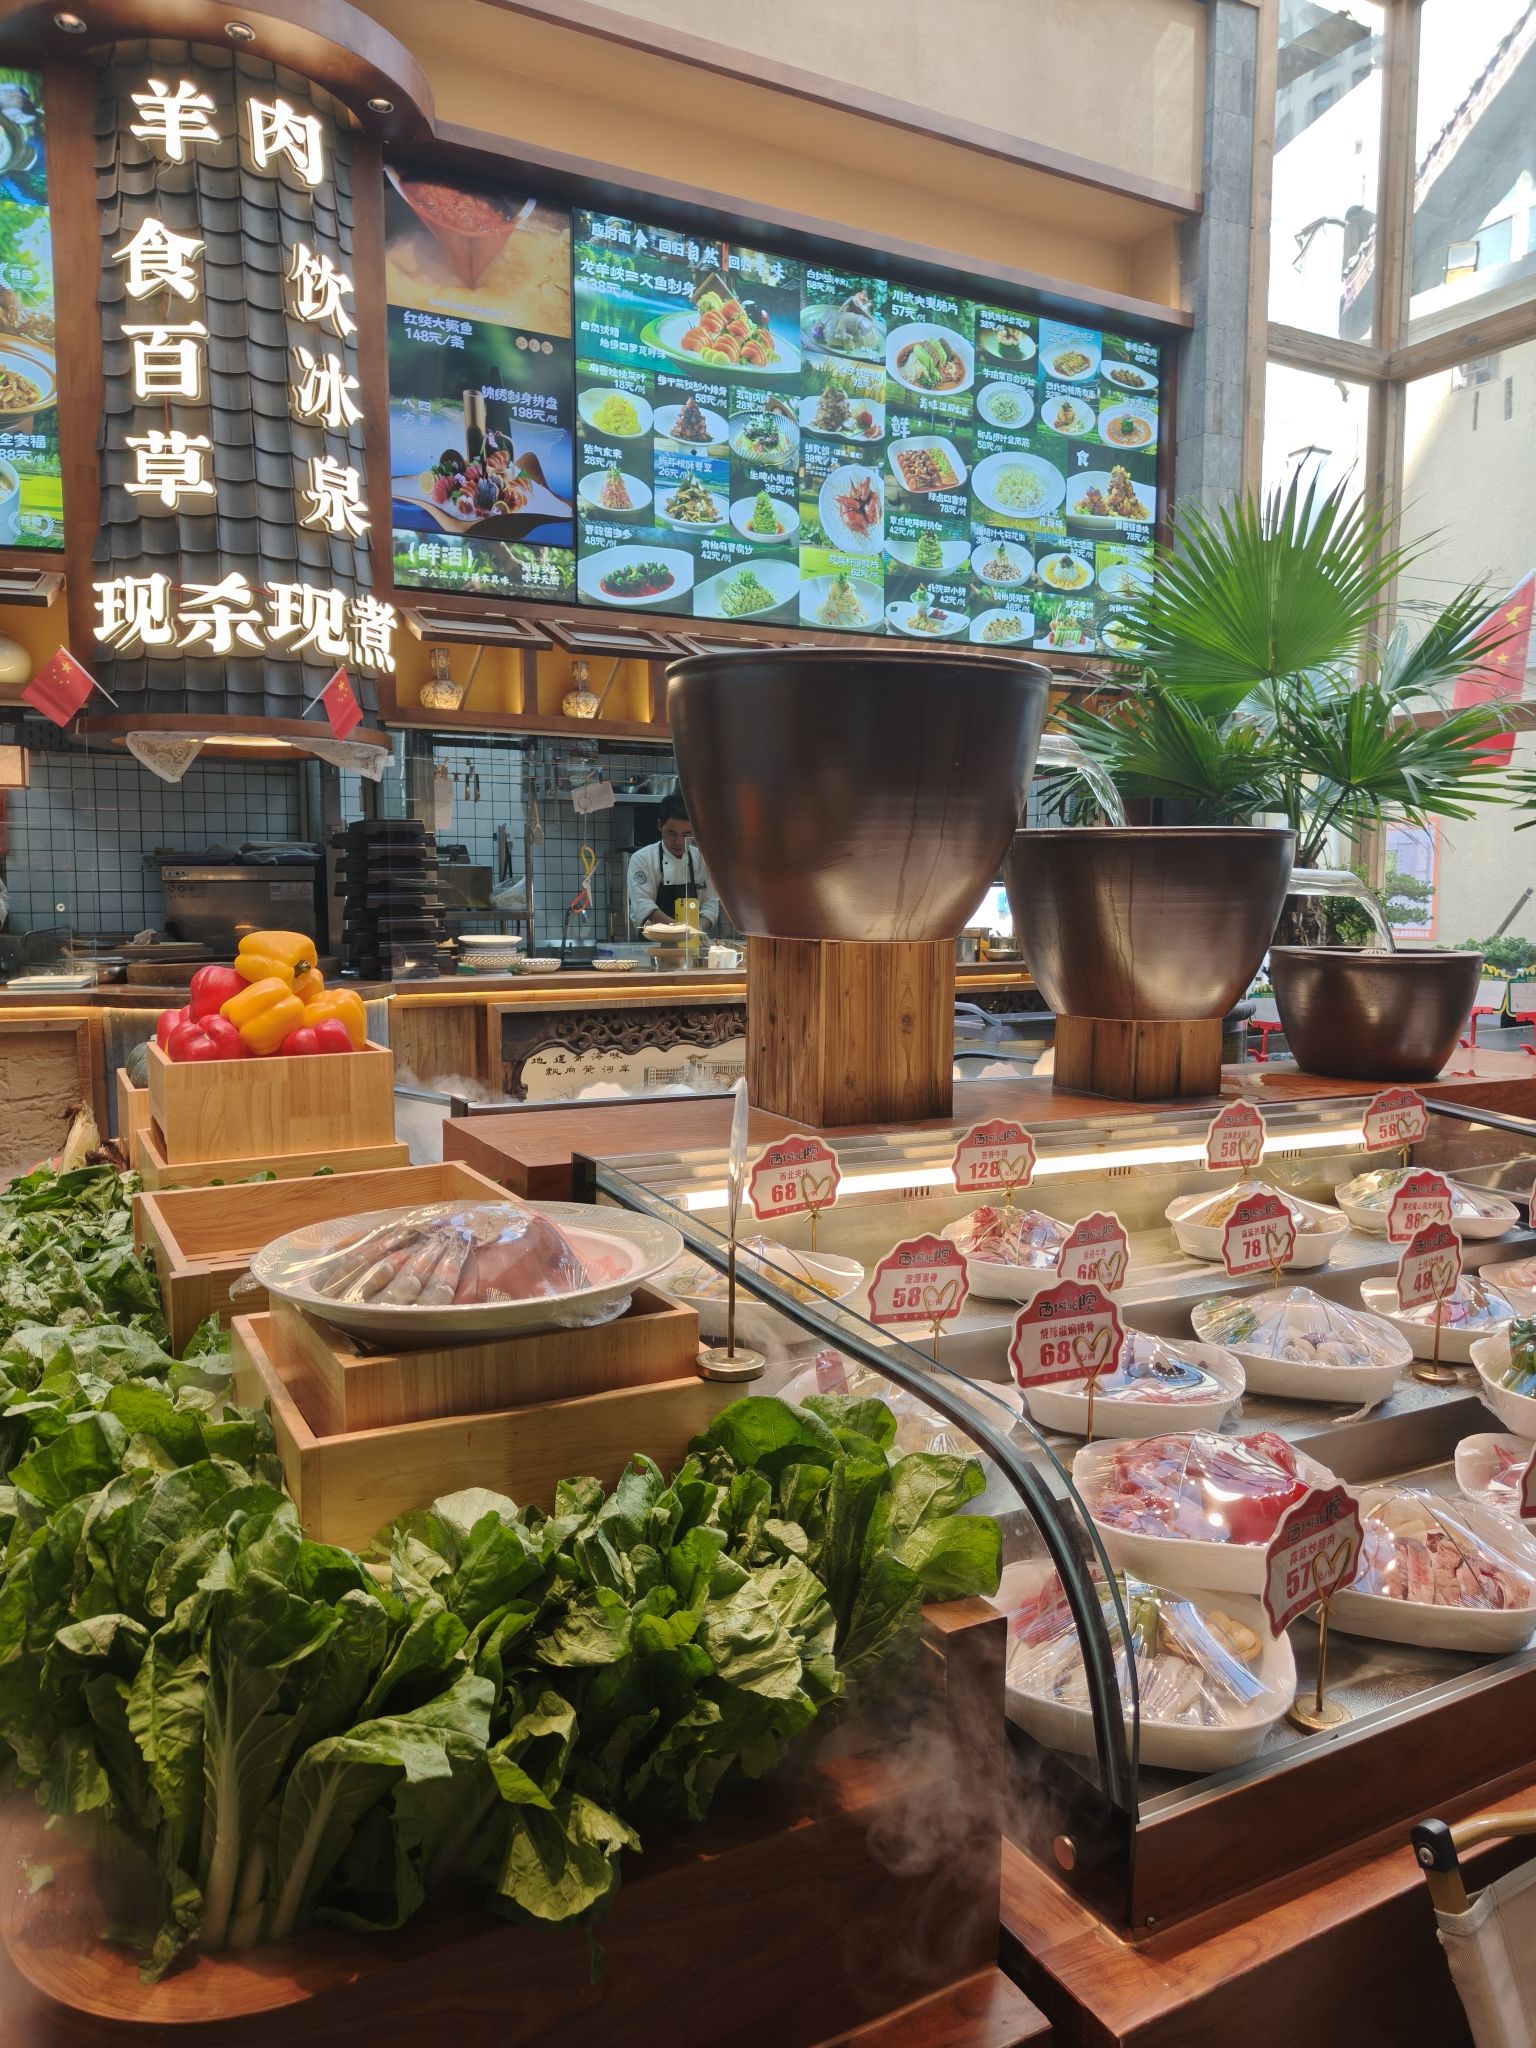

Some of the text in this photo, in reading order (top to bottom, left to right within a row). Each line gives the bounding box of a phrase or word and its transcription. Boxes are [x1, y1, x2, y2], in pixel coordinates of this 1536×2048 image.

[591, 222, 650, 251] 应时而食
[891, 289, 959, 316] 川式夫妻肺片
[404, 328, 465, 350] 148元/条
[481, 385, 559, 411] 锦绣刺身拼盘
[93, 572, 398, 672] 现杀现煮
[1378, 1122, 1397, 1139] 58
[1220, 1141, 1237, 1158] 58
[968, 1160, 1000, 1180] 128
[771, 1182, 797, 1204] 68
[1404, 1212, 1422, 1230] 88
[1242, 1238, 1262, 1260] 78
[1077, 1262, 1098, 1281] 68
[1412, 1270, 1432, 1293] 48
[892, 1286, 922, 1309] 58
[1040, 1340, 1071, 1368] 68
[1286, 1559, 1312, 1599] 57
